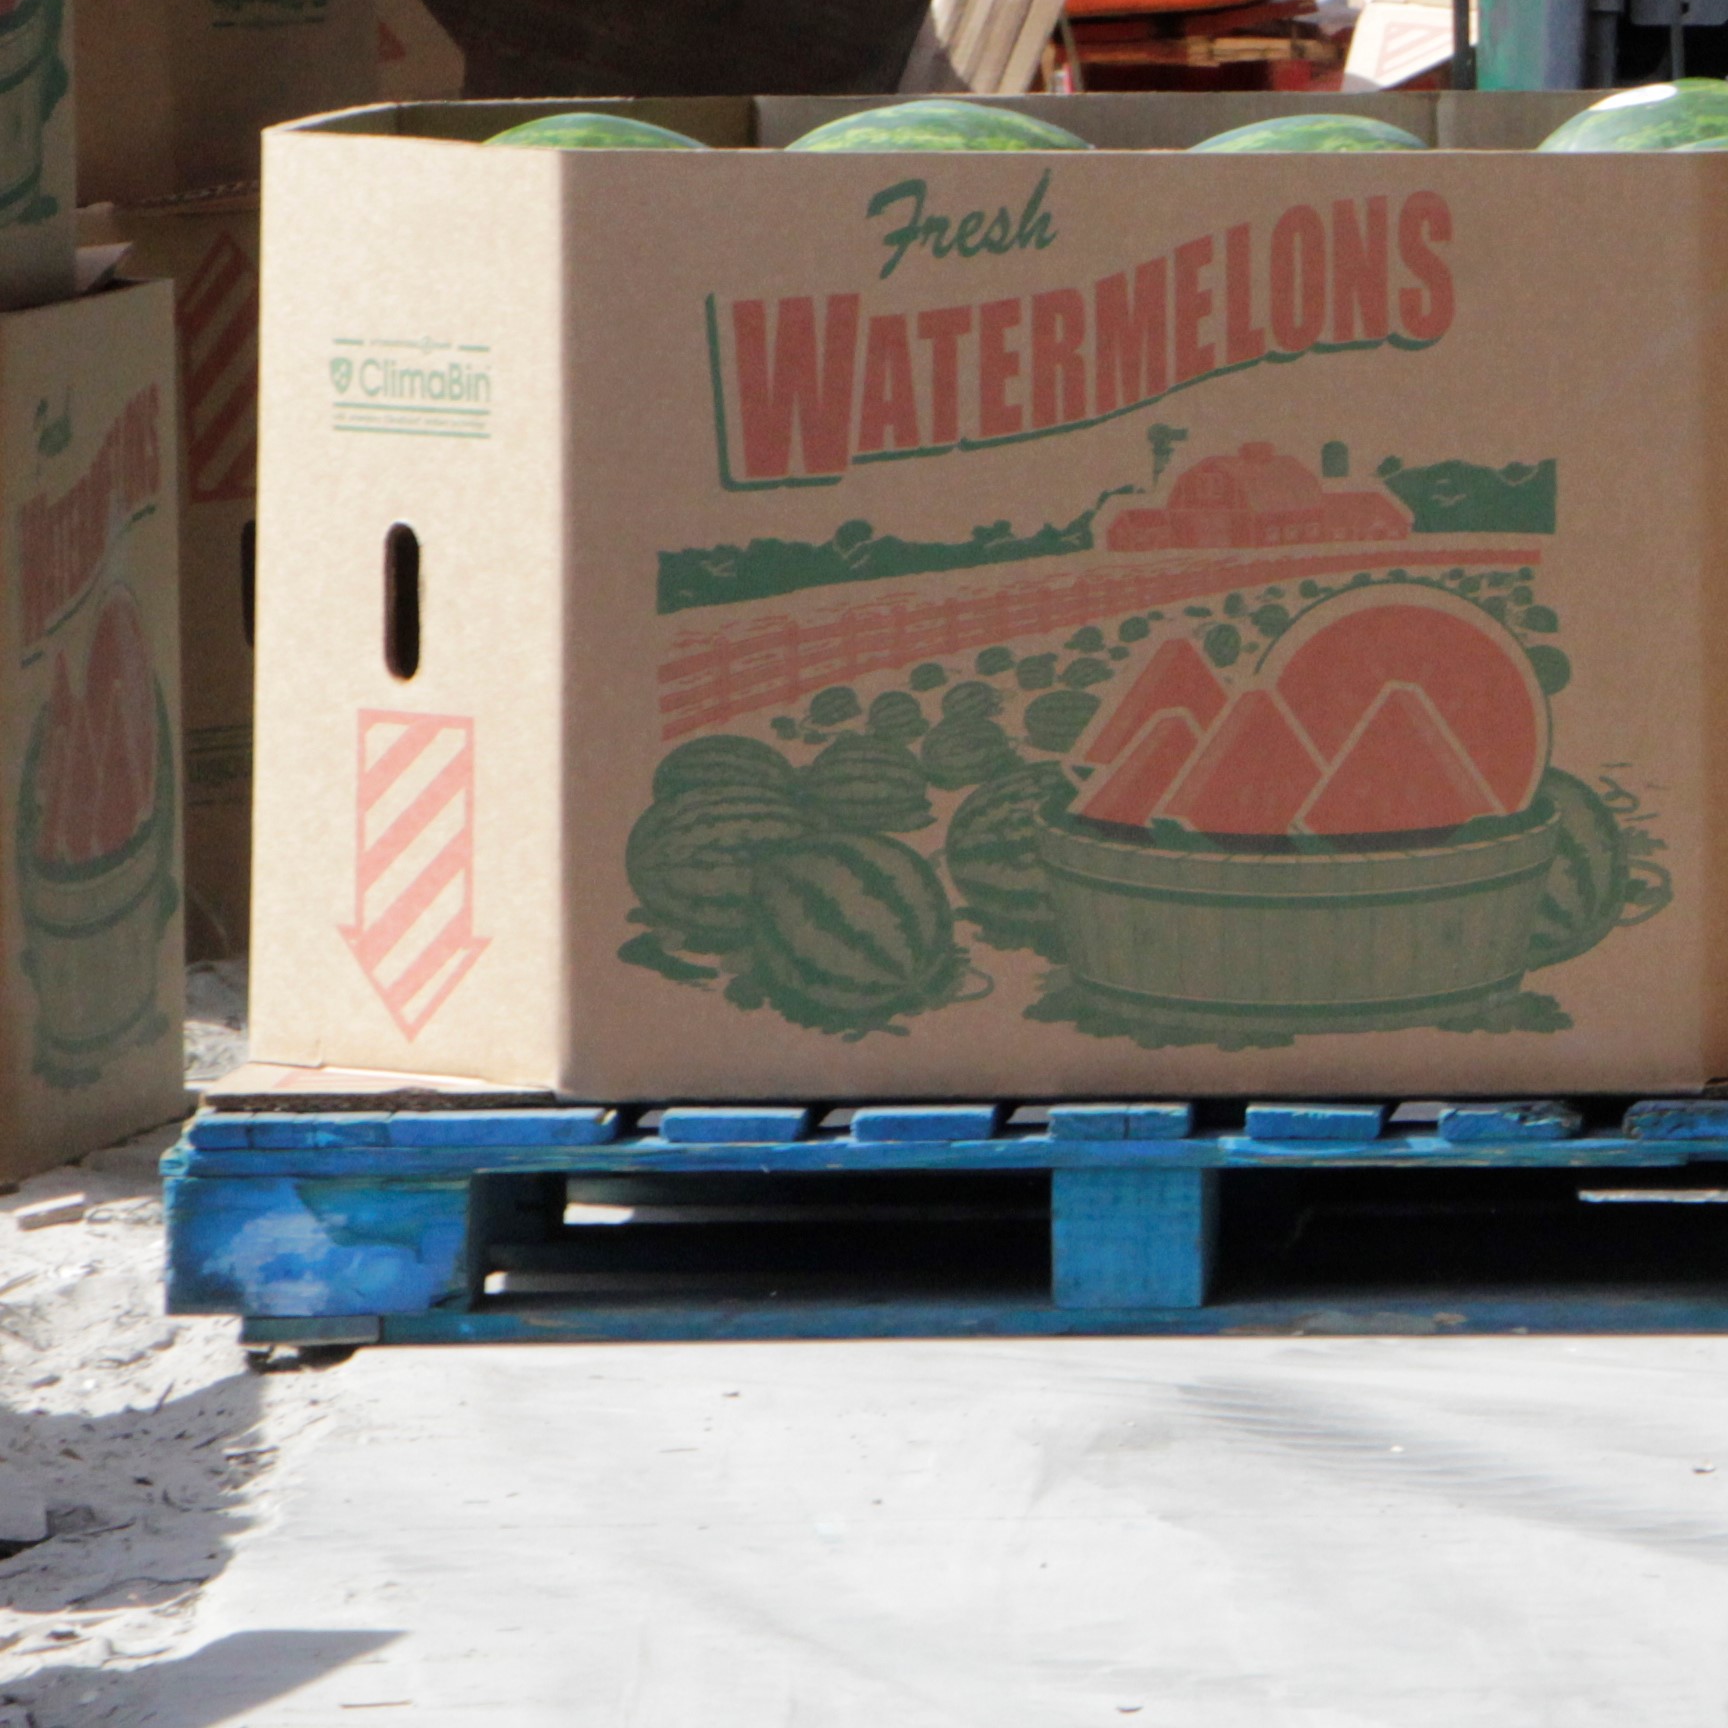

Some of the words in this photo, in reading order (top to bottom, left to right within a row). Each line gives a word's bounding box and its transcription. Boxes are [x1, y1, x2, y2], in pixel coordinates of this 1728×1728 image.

[867, 170, 1057, 279] Fresh
[360, 357, 492, 402] ClimaBin
[733, 190, 1456, 479] WATERMELONS
